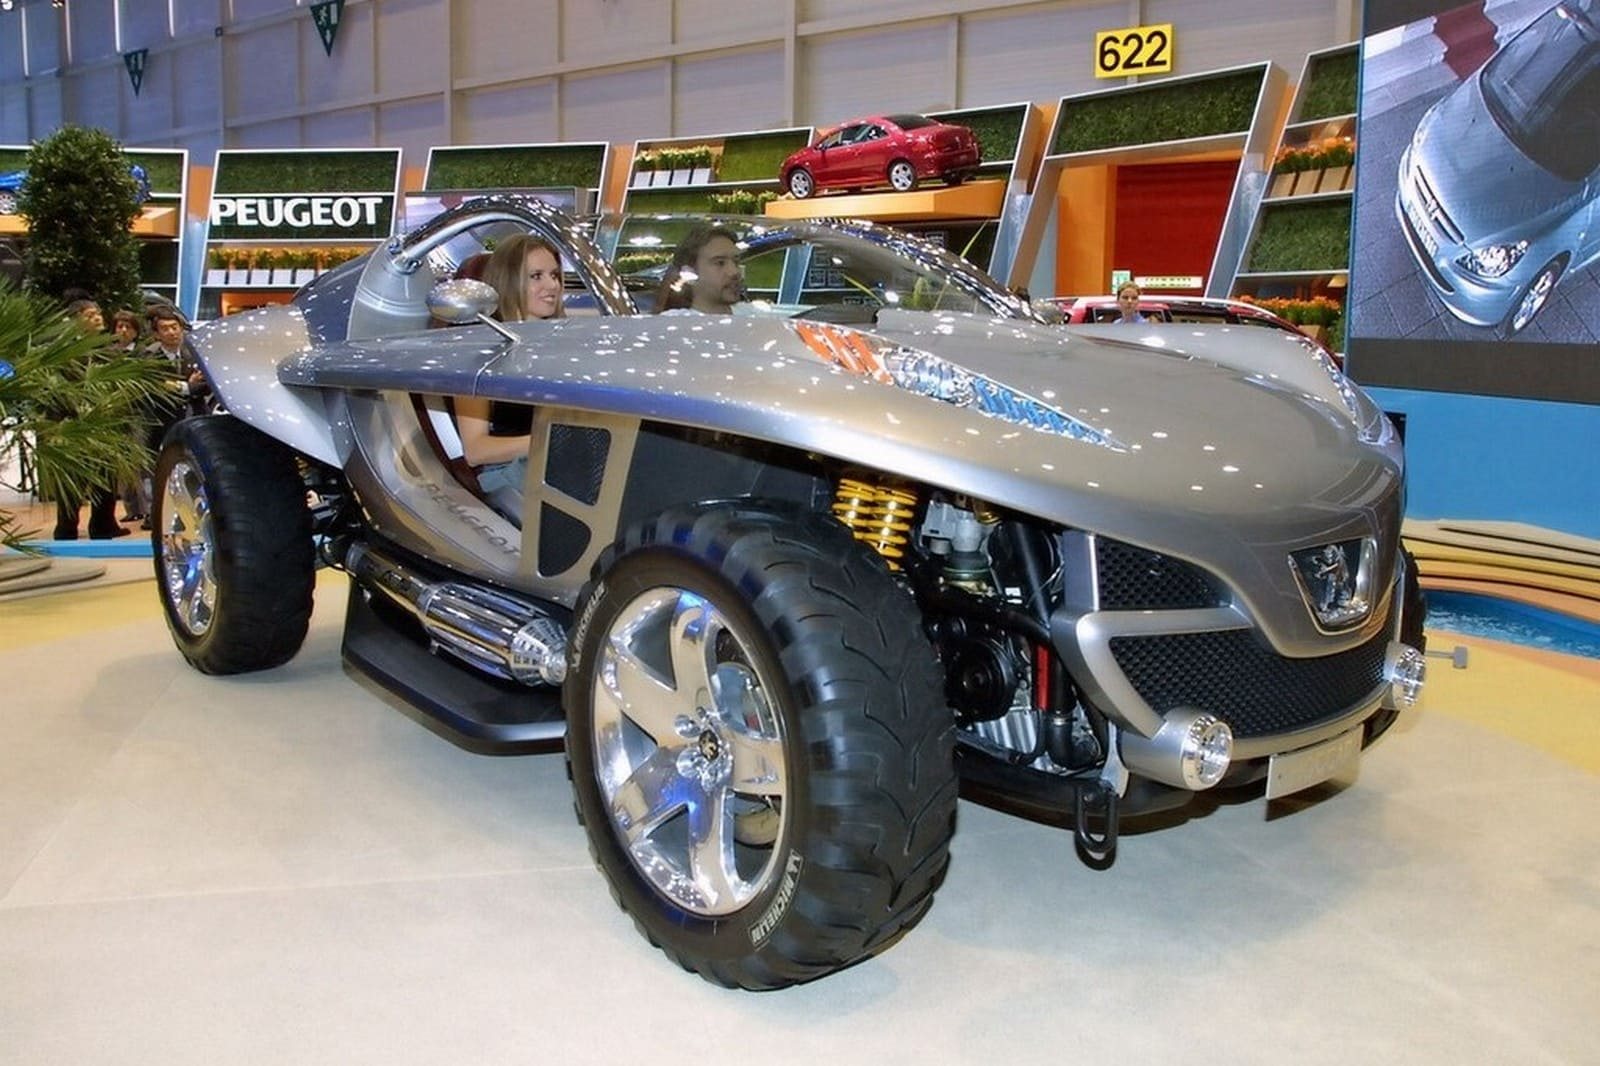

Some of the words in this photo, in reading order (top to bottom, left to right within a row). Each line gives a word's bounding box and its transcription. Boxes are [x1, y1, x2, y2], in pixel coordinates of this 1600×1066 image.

[1099, 30, 1168, 72] 622
[211, 197, 383, 227] PEUGEOT
[751, 872, 795, 943] MICHELIN
